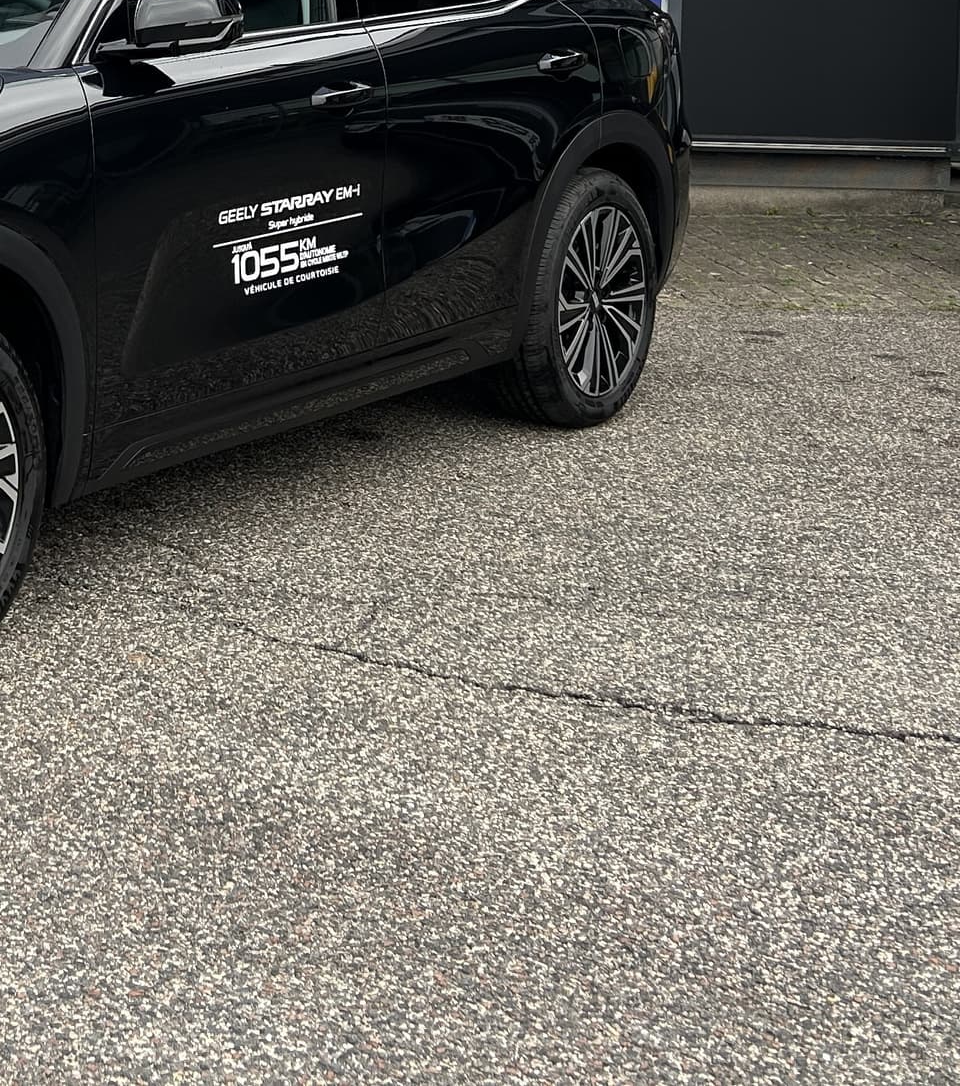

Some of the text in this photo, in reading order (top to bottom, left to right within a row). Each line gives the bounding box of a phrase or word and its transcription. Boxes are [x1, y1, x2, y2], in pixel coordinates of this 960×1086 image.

[218, 203, 259, 226] GEELY
[260, 188, 334, 217] STARRAY
[267, 212, 315, 231] Super hybride
[231, 235, 317, 285] 1055 KM
[243, 265, 340, 296] VÉHICULE DE COURTOISIE
